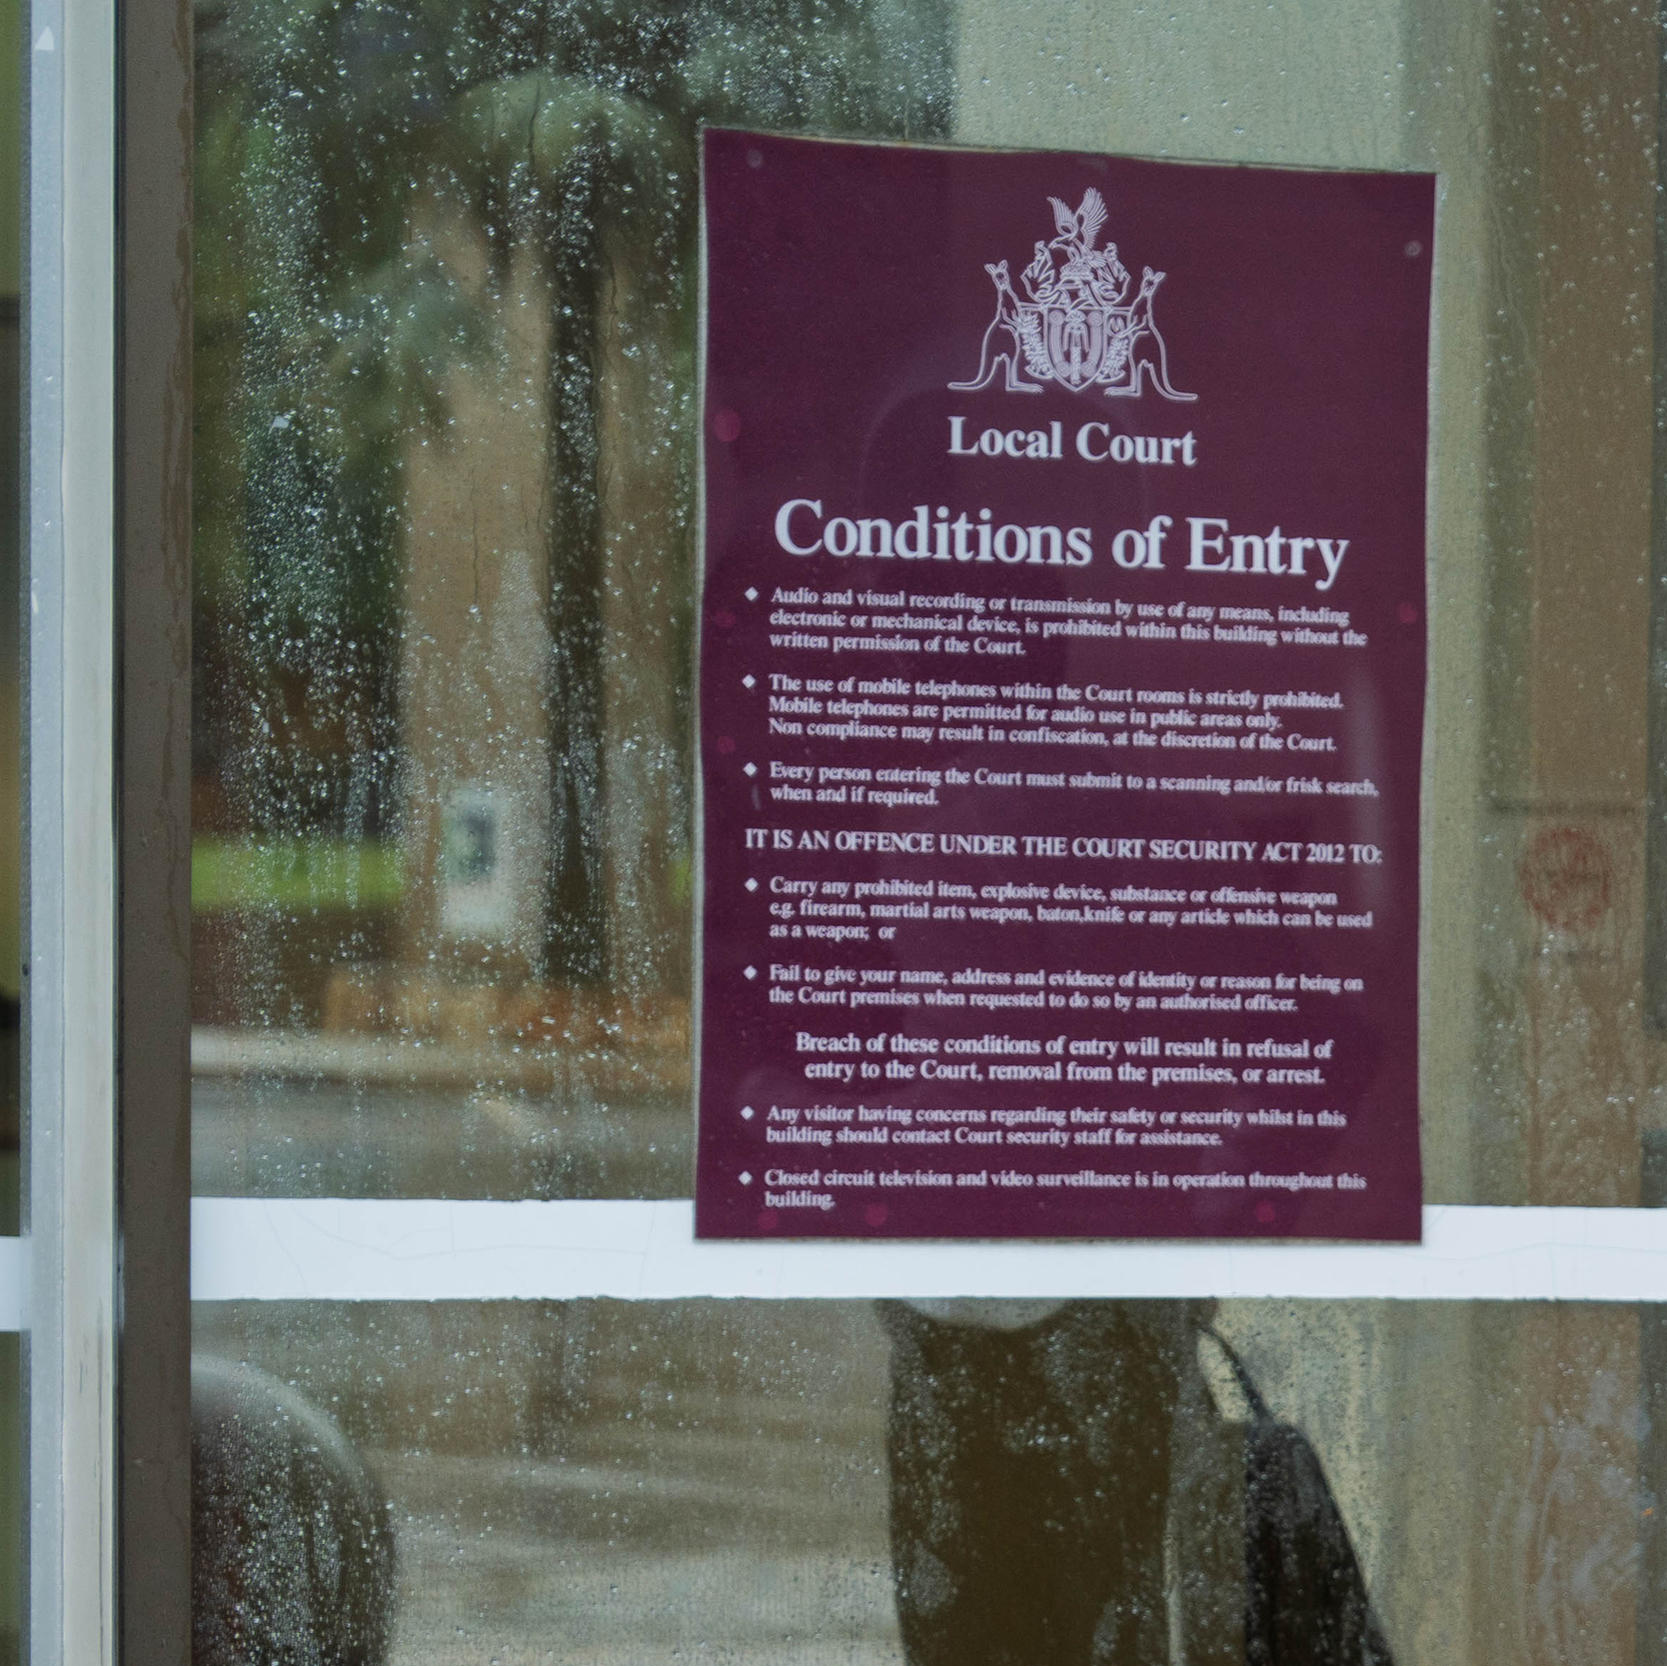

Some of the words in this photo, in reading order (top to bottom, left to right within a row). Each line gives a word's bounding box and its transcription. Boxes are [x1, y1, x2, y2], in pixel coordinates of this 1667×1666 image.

[947, 415, 1064, 459] Local
[1075, 422, 1197, 467] Court
[774, 498, 1093, 567] Conditions
[1111, 514, 1173, 569] of
[1184, 517, 1350, 591] Entry
[771, 674, 802, 691] The
[805, 678, 834, 692] use
[836, 676, 855, 693] of
[857, 677, 911, 695] mobile
[914, 679, 997, 700] telephones
[1000, 681, 1052, 699] within
[1055, 683, 1082, 700] the
[1084, 684, 1133, 702] Court
[1136, 690, 1186, 704] rooms
[768, 695, 823, 713] Mobile
[826, 698, 909, 719] telephones
[912, 704, 939, 718] are
[942, 702, 1022, 722] permitted
[1025, 704, 1048, 721] for
[1050, 705, 1095, 723] audio
[1098, 710, 1126, 724] use
[1129, 708, 1147, 724] in
[1149, 708, 1198, 728] public
[1199, 713, 1243, 727] areas
[768, 717, 803, 734] Non
[806, 719, 897, 740] compliance
[900, 725, 935, 741] may
[938, 723, 984, 741] result
[987, 725, 1005, 742] in
[1112, 730, 1129, 745] at
[1131, 729, 1158, 746] the
[1238, 732, 1256, 749] of
[1258, 733, 1284, 750] the
[769, 762, 815, 782] Every
[818, 767, 872, 783] person
[874, 766, 942, 786] entering
[944, 767, 970, 784] the
[973, 768, 1022, 786] Court
[1025, 771, 1066, 787] must
[1068, 771, 1123, 788] submit
[1125, 774, 1143, 789] to
[1145, 776, 1157, 789] a
[1159, 774, 1231, 794] scanning
[770, 783, 813, 801] when
[815, 785, 847, 802] and
[850, 786, 864, 803] if
[866, 786, 938, 807] required.
[745, 829, 768, 848] IT
[772, 830, 793, 849] IS
[798, 831, 829, 850] AN
[834, 832, 935, 852] OFFENCE
[939, 835, 1016, 855] UNDER
[1020, 837, 1068, 856] THE
[1071, 838, 1146, 858] COURT
[1148, 840, 1257, 861] SECURITY
[1260, 843, 1304, 862] ACT
[1304, 844, 1346, 863] 2012
[1347, 845, 1382, 864] TO:
[795, 1032, 862, 1052] Breach
[865, 1033, 886, 1052] of
[889, 1033, 939, 1053] these
[943, 1034, 1041, 1054] conditions
[1044, 1035, 1066, 1054] of
[1068, 1038, 1119, 1058] entry
[1123, 1036, 1160, 1056] will
[1164, 1037, 1218, 1057] result
[1221, 1038, 1242, 1057] in
[1246, 1038, 1310, 1058] refusal
[1312, 1039, 1333, 1058] of
[804, 1061, 855, 1081] entry
[860, 1061, 880, 1078] to
[884, 1059, 916, 1078] the
[919, 1060, 983, 1081] Court,
[988, 1060, 1062, 1080] removal
[1066, 1061, 1113, 1081] from
[1116, 1062, 1148, 1081] the
[1241, 1068, 1263, 1083] or
[764, 1169, 820, 1186] Closed
[822, 1169, 875, 1186] circuit
[878, 1169, 953, 1186] television
[955, 1169, 988, 1186] and
[990, 1169, 1034, 1186] video
[1036, 1169, 1132, 1187] surveillance
[1151, 1171, 1170, 1187] in
[1172, 1171, 1246, 1190] operation
[1336, 1172, 1366, 1189] this
